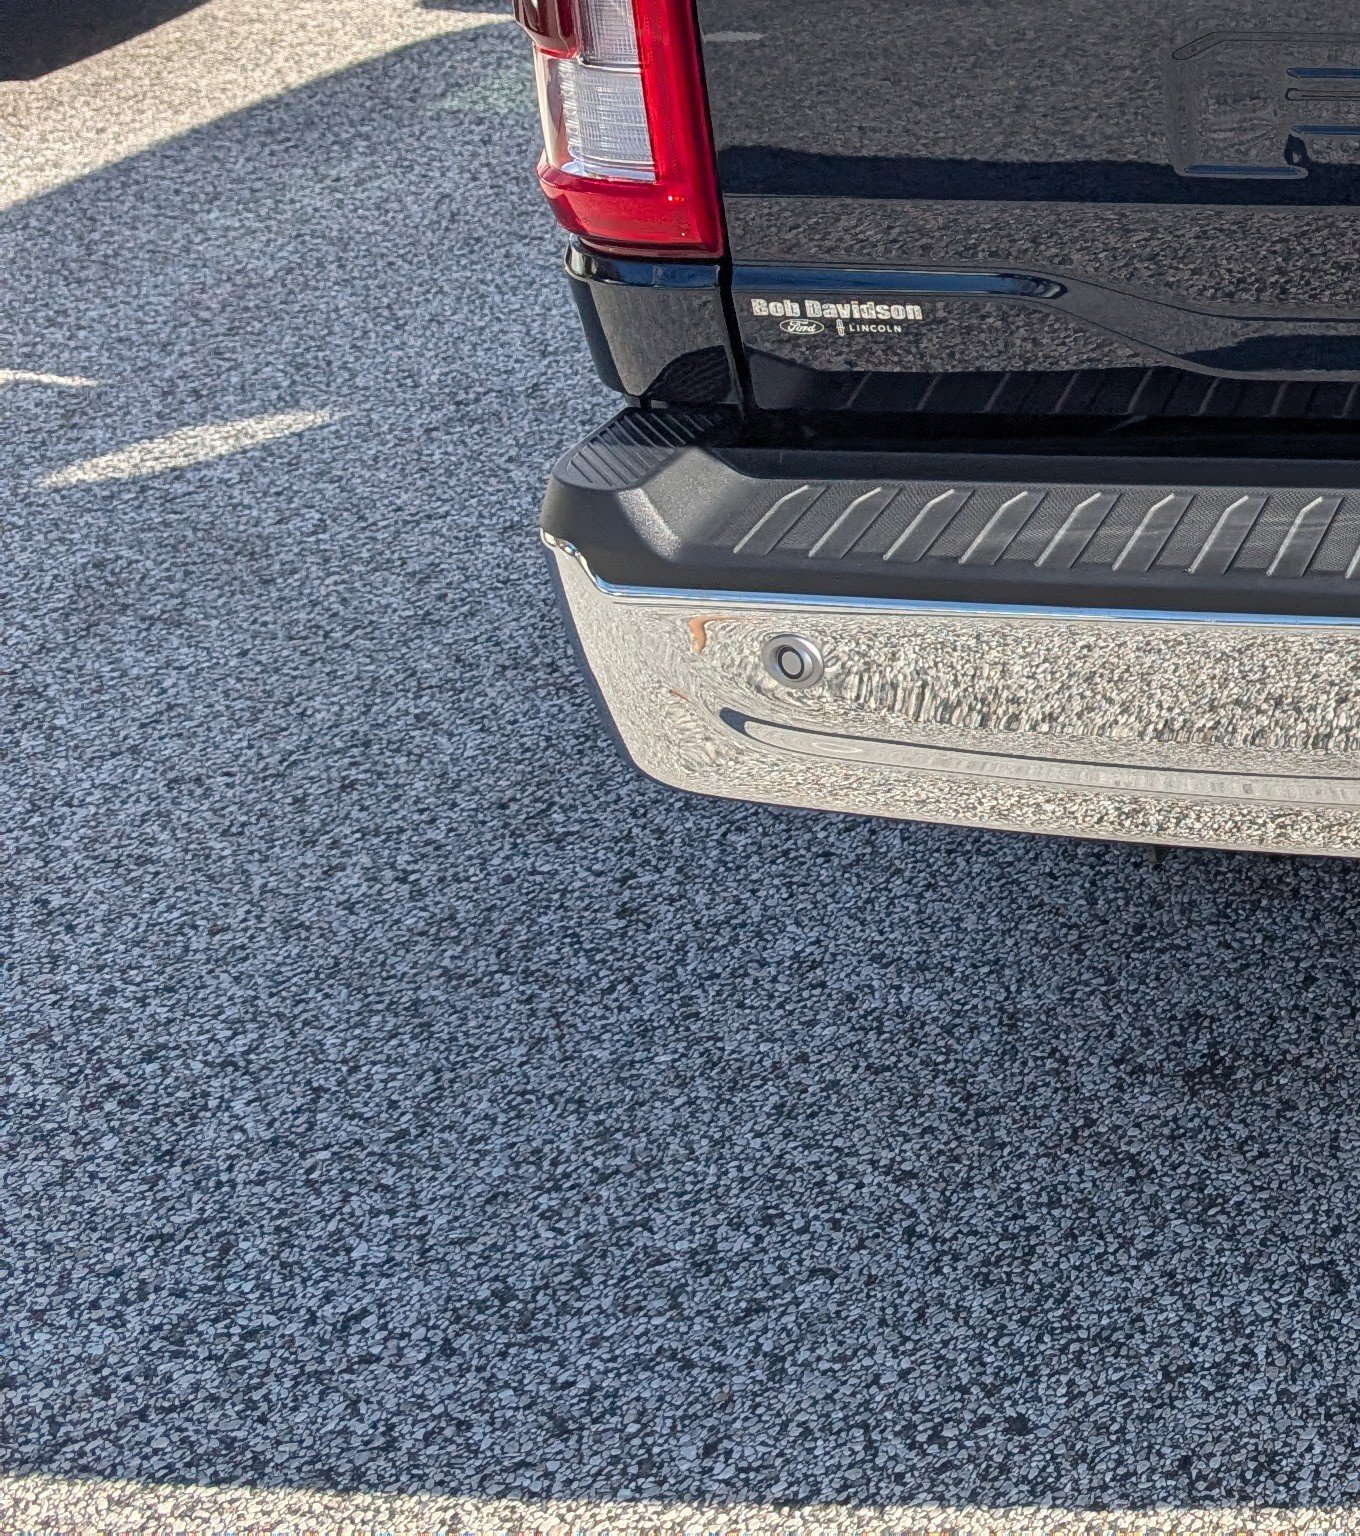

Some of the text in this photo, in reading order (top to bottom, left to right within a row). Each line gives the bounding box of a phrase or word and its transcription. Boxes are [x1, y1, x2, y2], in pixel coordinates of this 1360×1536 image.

[751, 298, 923, 320] Bob Davidson
[849, 323, 902, 333] LINCOLN
